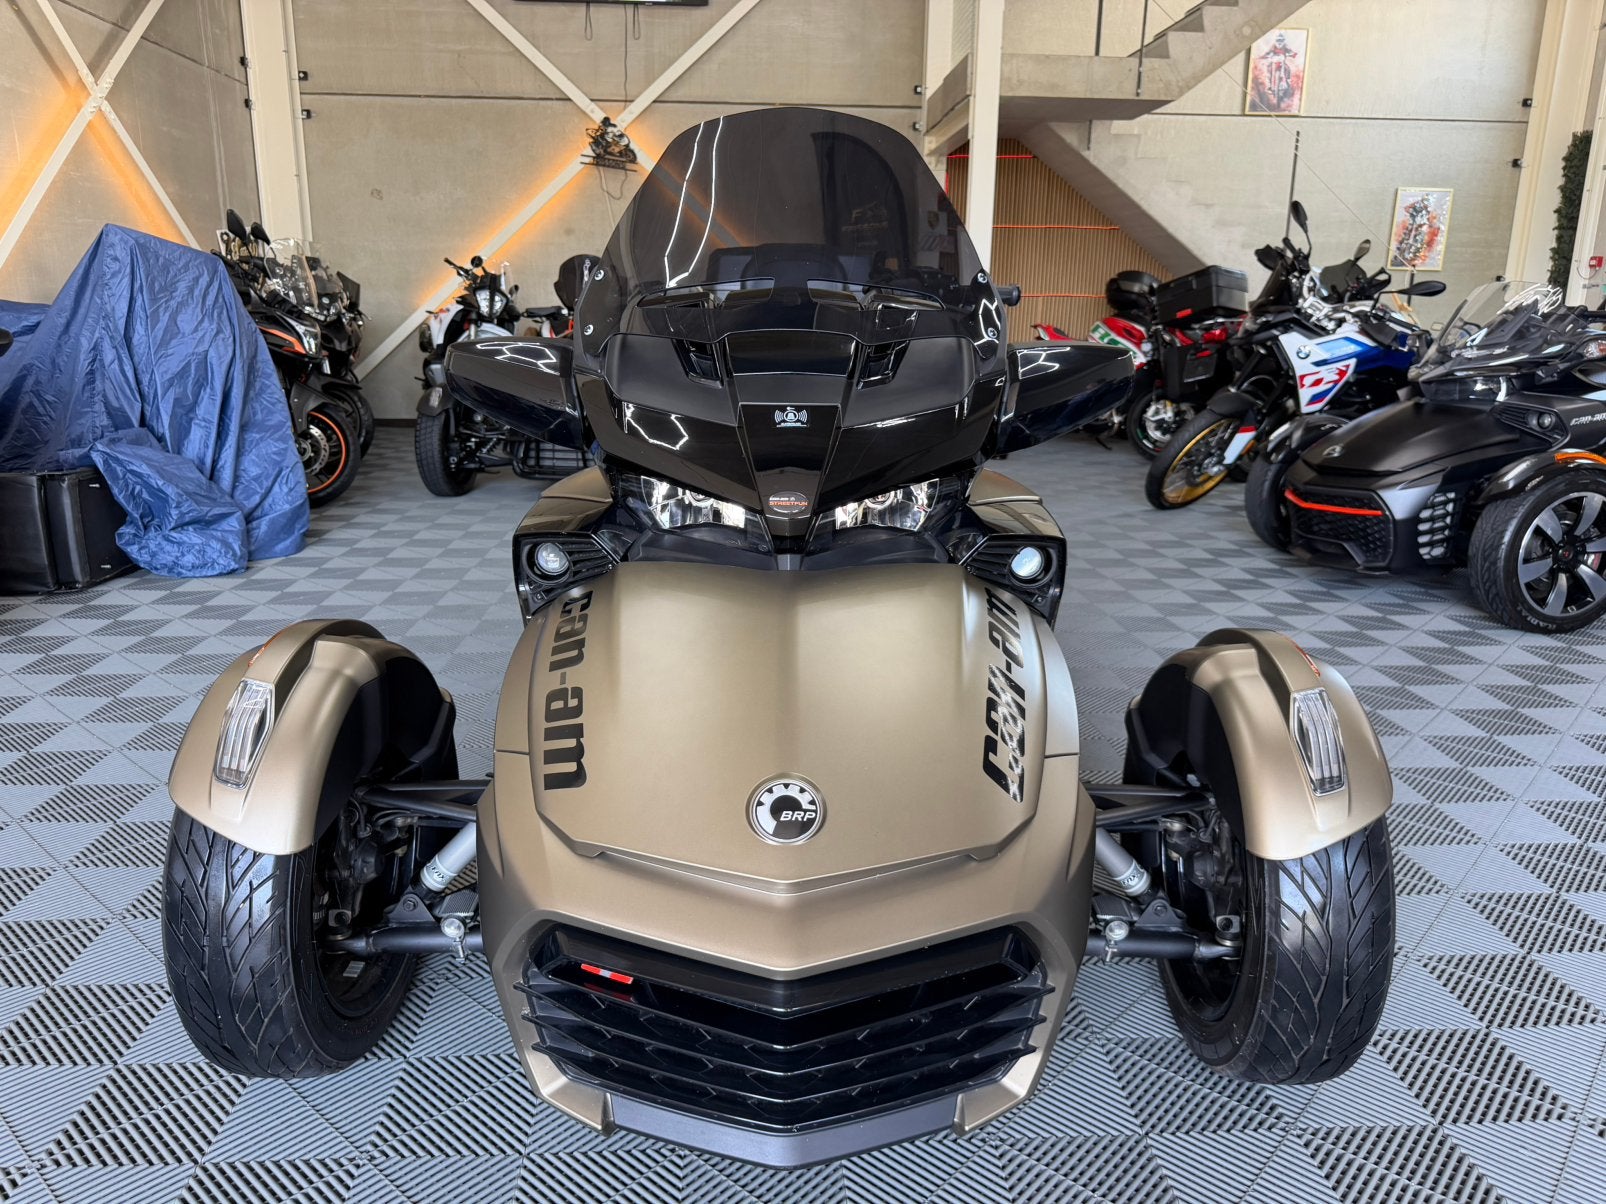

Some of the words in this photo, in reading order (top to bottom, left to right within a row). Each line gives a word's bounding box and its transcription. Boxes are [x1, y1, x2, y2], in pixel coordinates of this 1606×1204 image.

[543, 590, 594, 791] can-am
[982, 588, 1025, 803] can-am
[780, 810, 816, 823] BRP
